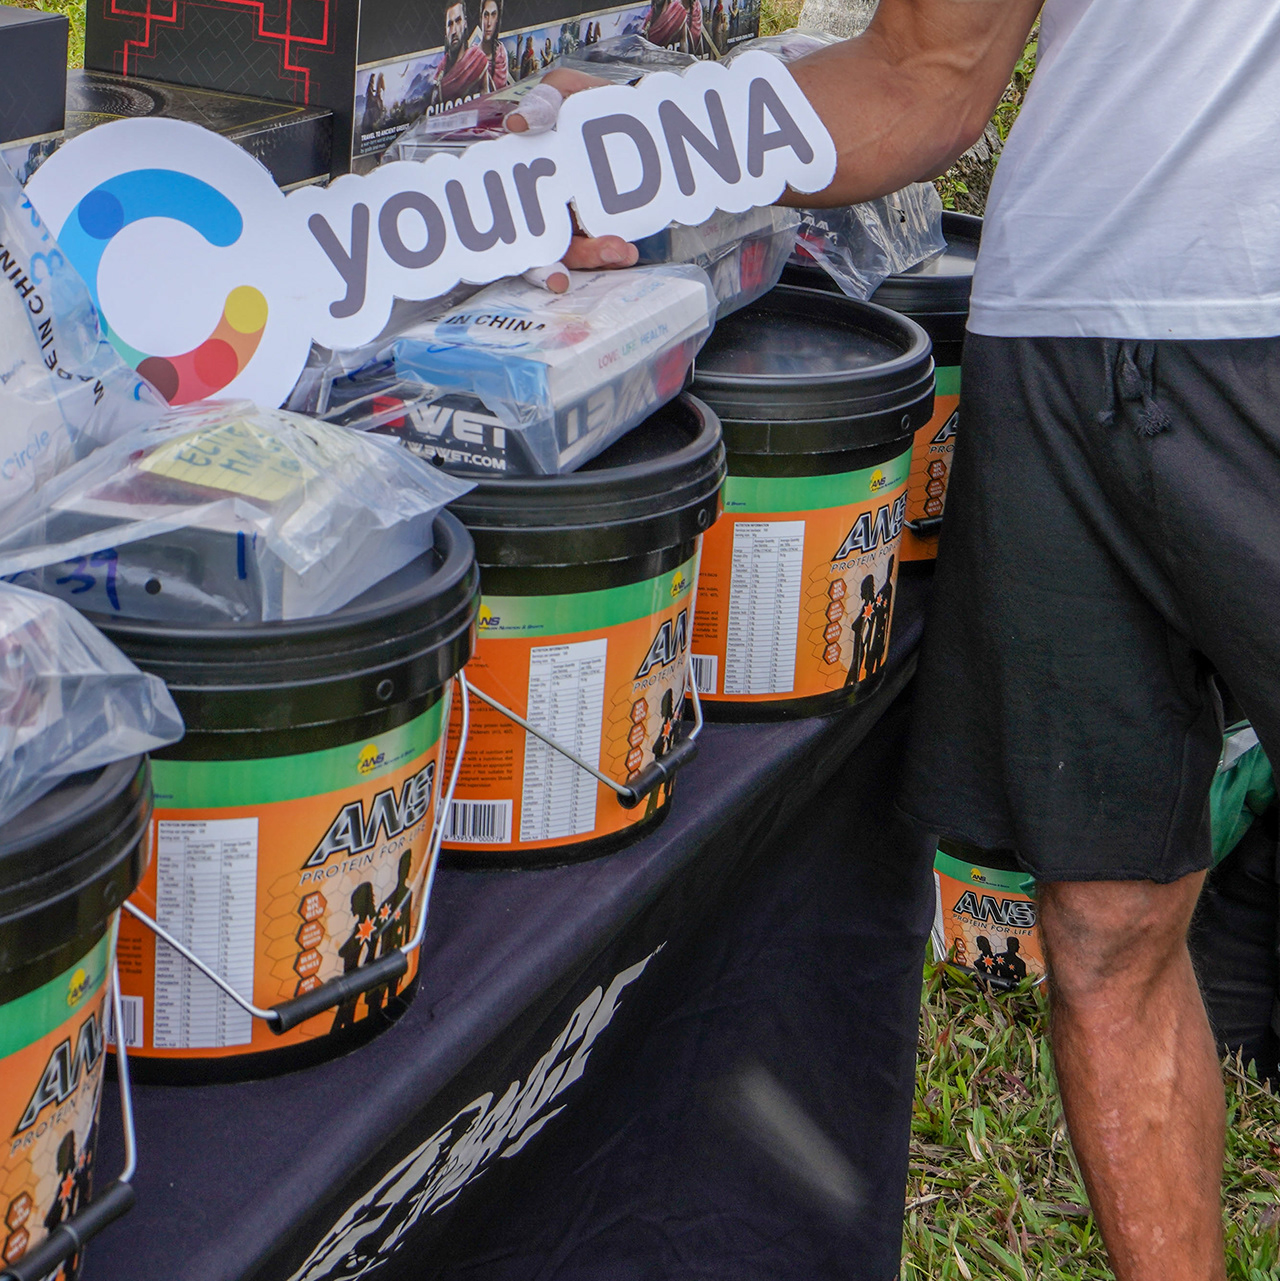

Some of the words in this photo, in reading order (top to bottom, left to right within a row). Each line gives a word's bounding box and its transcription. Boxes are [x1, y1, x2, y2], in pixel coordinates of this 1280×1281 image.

[307, 157, 556, 319] your
[581, 75, 814, 216] DNA
[38, 317, 56, 349] IN
[598, 354, 619, 370] LOVE
[640, 324, 669, 345] HEALTH
[45, 349, 105, 406] MADE
[1, 430, 50, 480] Circle
[871, 476, 886, 488] ANS
[830, 552, 876, 574] PROTEIN
[634, 608, 688, 680] AN
[632, 667, 674, 694] PROTEIN
[360, 752, 386, 769] ANS
[301, 759, 436, 870] ANS
[299, 852, 374, 887] PROTEIN
[379, 837, 406, 859] FOR
[972, 874, 986, 882] ANS
[952, 890, 1036, 928] ANS
[953, 914, 987, 929] PROTEIN
[990, 926, 1010, 934] FOR
[299, 959, 320, 973] MUSCLE
[300, 952, 317, 964] BUILD
[12, 994, 106, 1136] AN
[10, 1101, 77, 1158] PROTEIN
